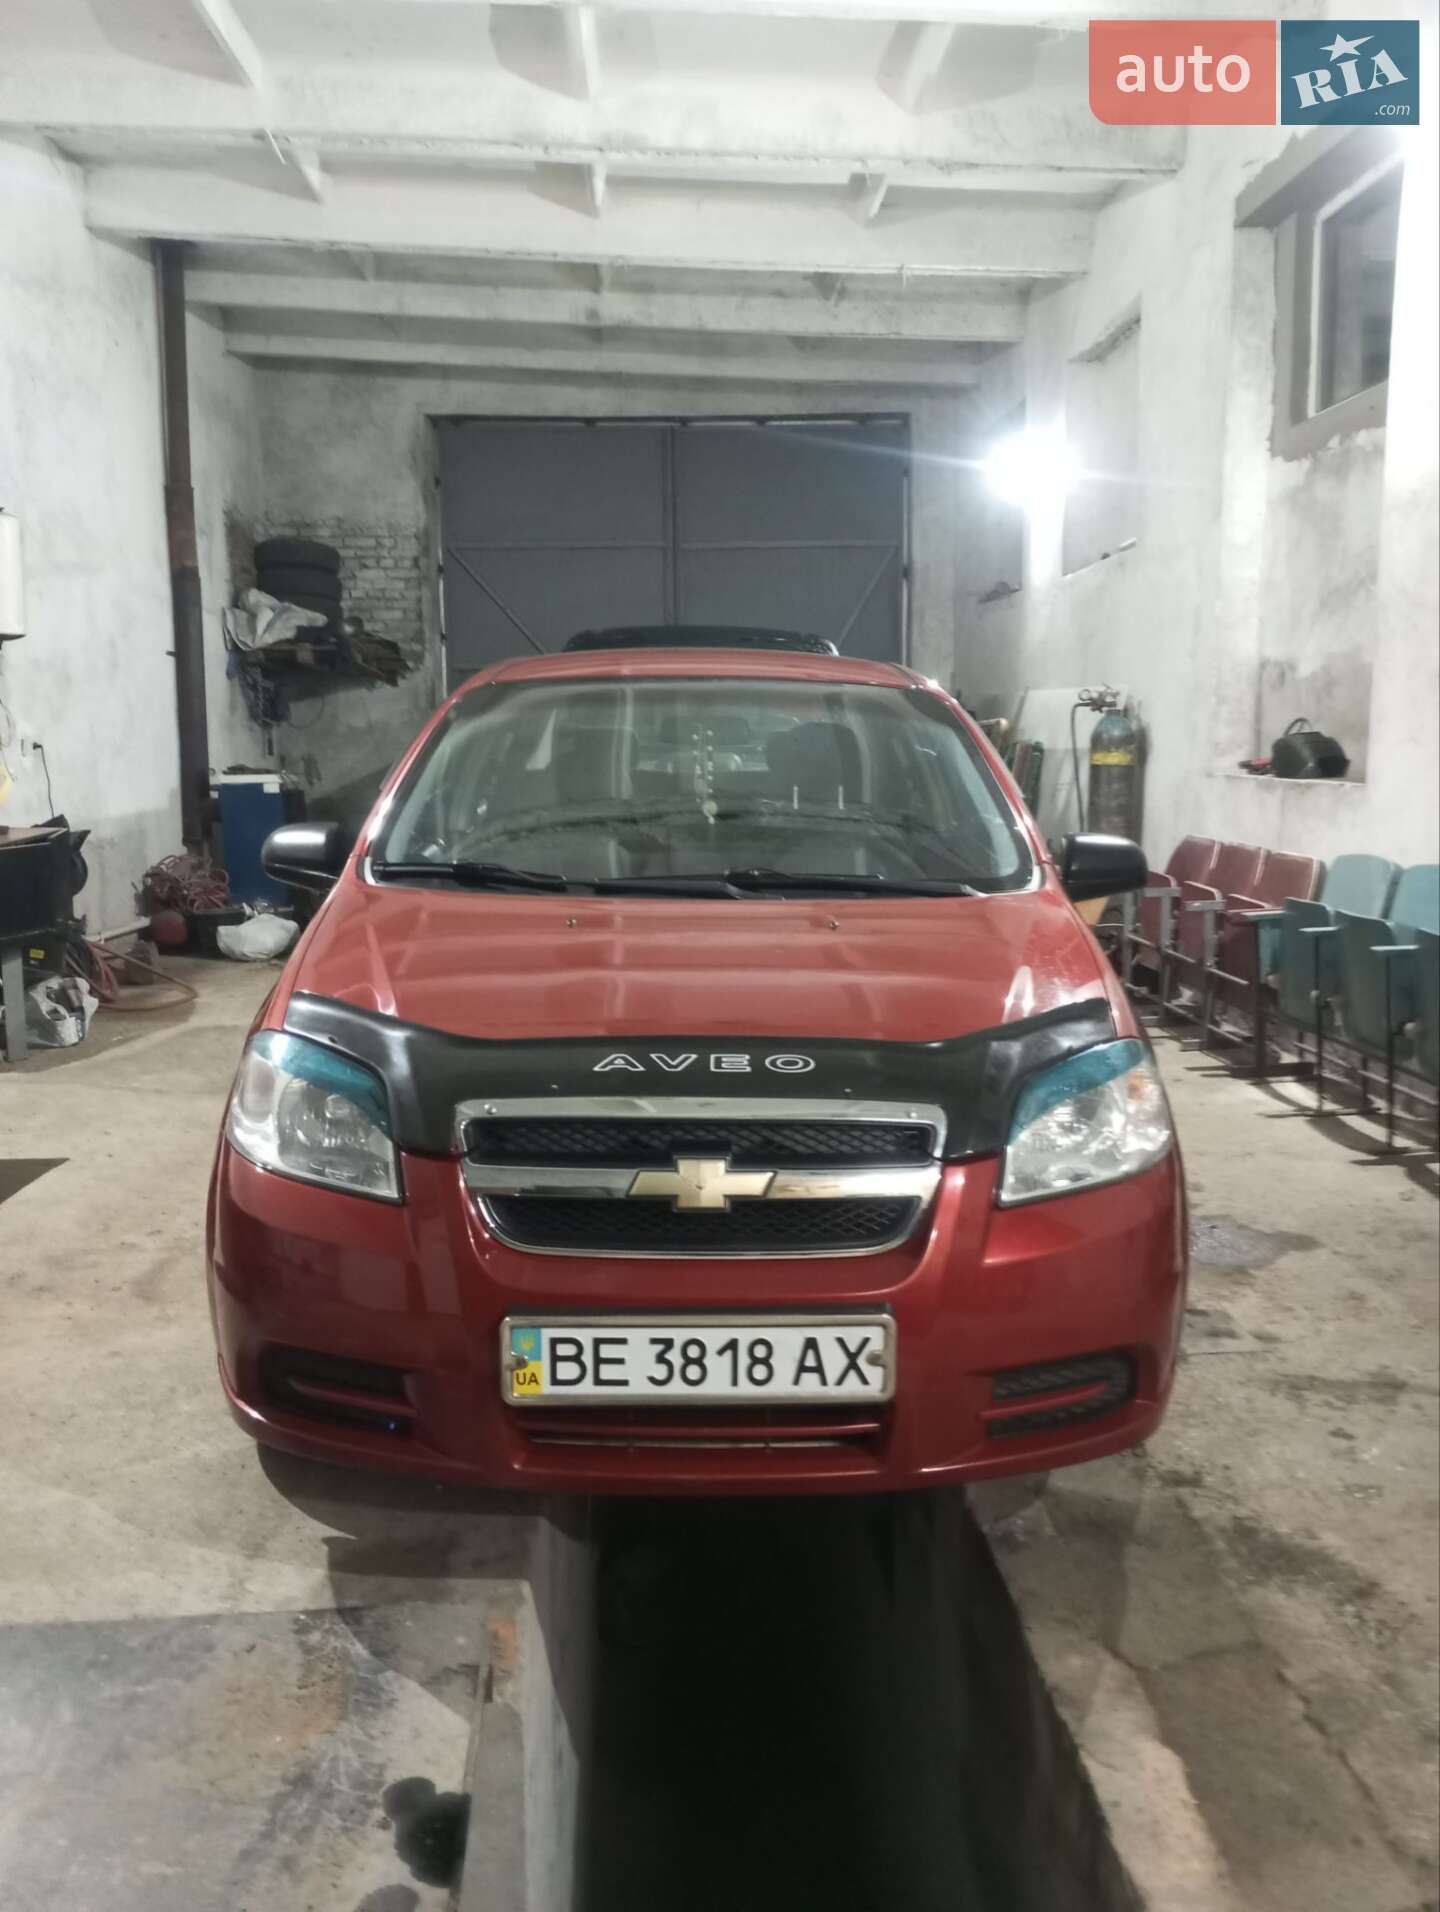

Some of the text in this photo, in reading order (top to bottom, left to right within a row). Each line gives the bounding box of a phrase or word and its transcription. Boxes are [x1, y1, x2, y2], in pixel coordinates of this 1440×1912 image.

[593, 1053, 815, 1073] AVEO
[548, 1336, 871, 1388] BE 3818 AX
[515, 1371, 539, 1386] UA
